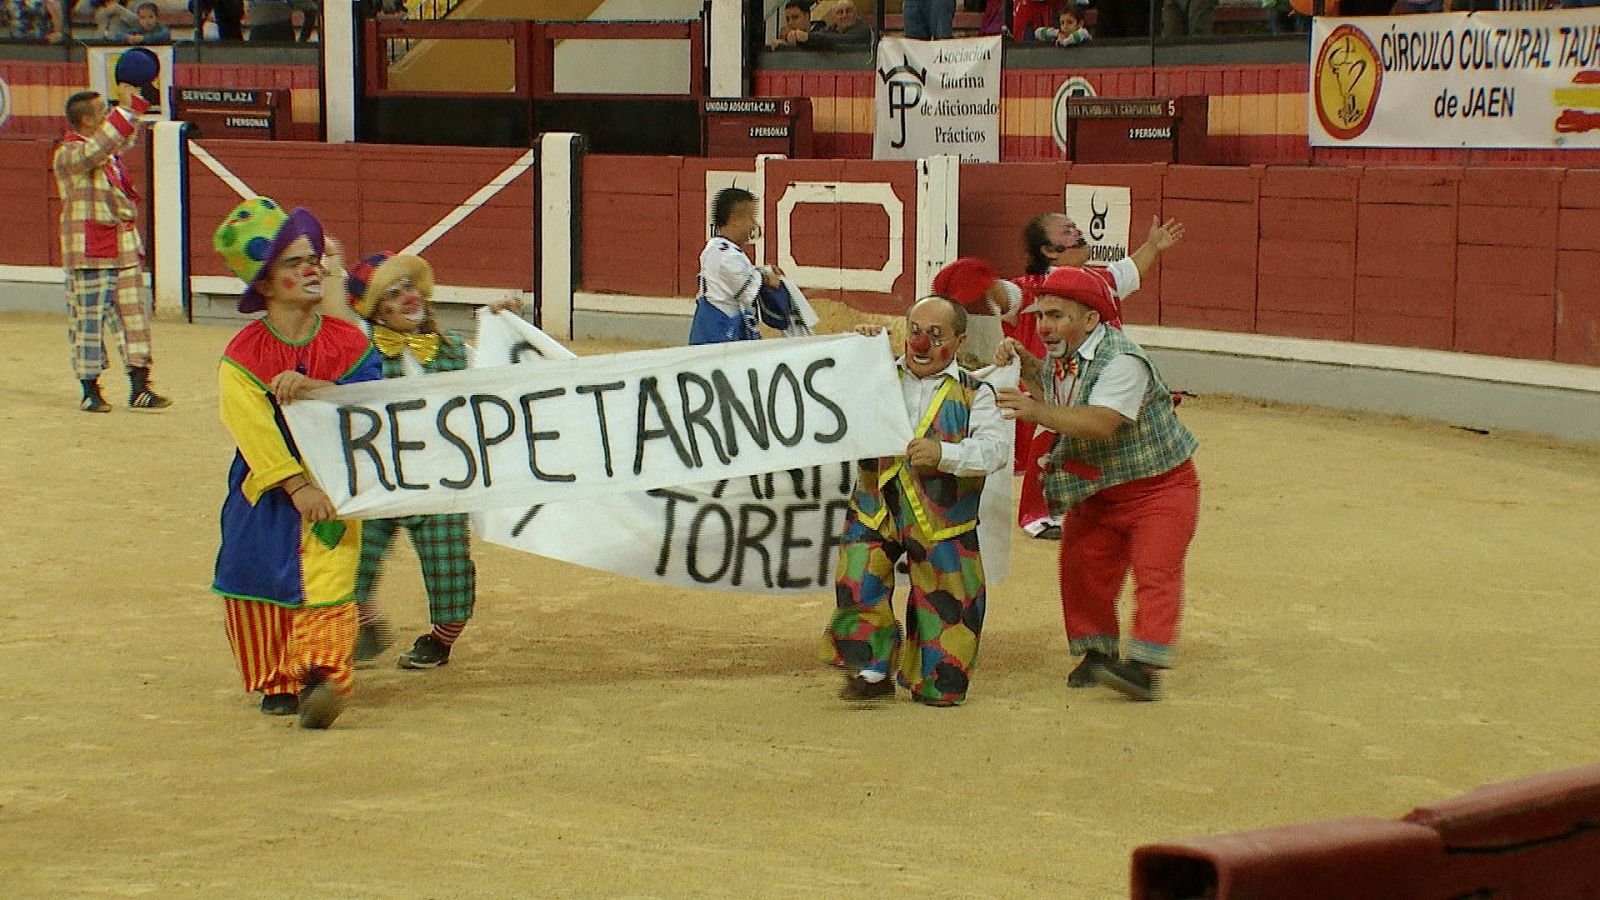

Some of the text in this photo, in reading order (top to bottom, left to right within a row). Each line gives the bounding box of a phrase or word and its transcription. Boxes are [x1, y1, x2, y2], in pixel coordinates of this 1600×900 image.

[933, 45, 991, 64] Asociación
[1380, 24, 1454, 72] CÍRCULO
[1459, 28, 1551, 70] CULTURAL
[941, 73, 985, 90] Taurina
[182, 90, 272, 105] SERVICIO PLAZA 7
[1434, 86, 1515, 118] de JAEN
[705, 101, 729, 112] UNIDAD
[783, 100, 791, 115] 6
[920, 100, 933, 116] de
[1168, 100, 1176, 117] 5
[232, 118, 269, 128] PERSONAS
[749, 127, 788, 137] 2 PERSONAS
[935, 126, 986, 143] Prácticos
[1129, 127, 1171, 138] 2 PERSONAS
[1089, 243, 1126, 262] EMOCIÓN
[337, 357, 848, 498] RESPETARNOS
